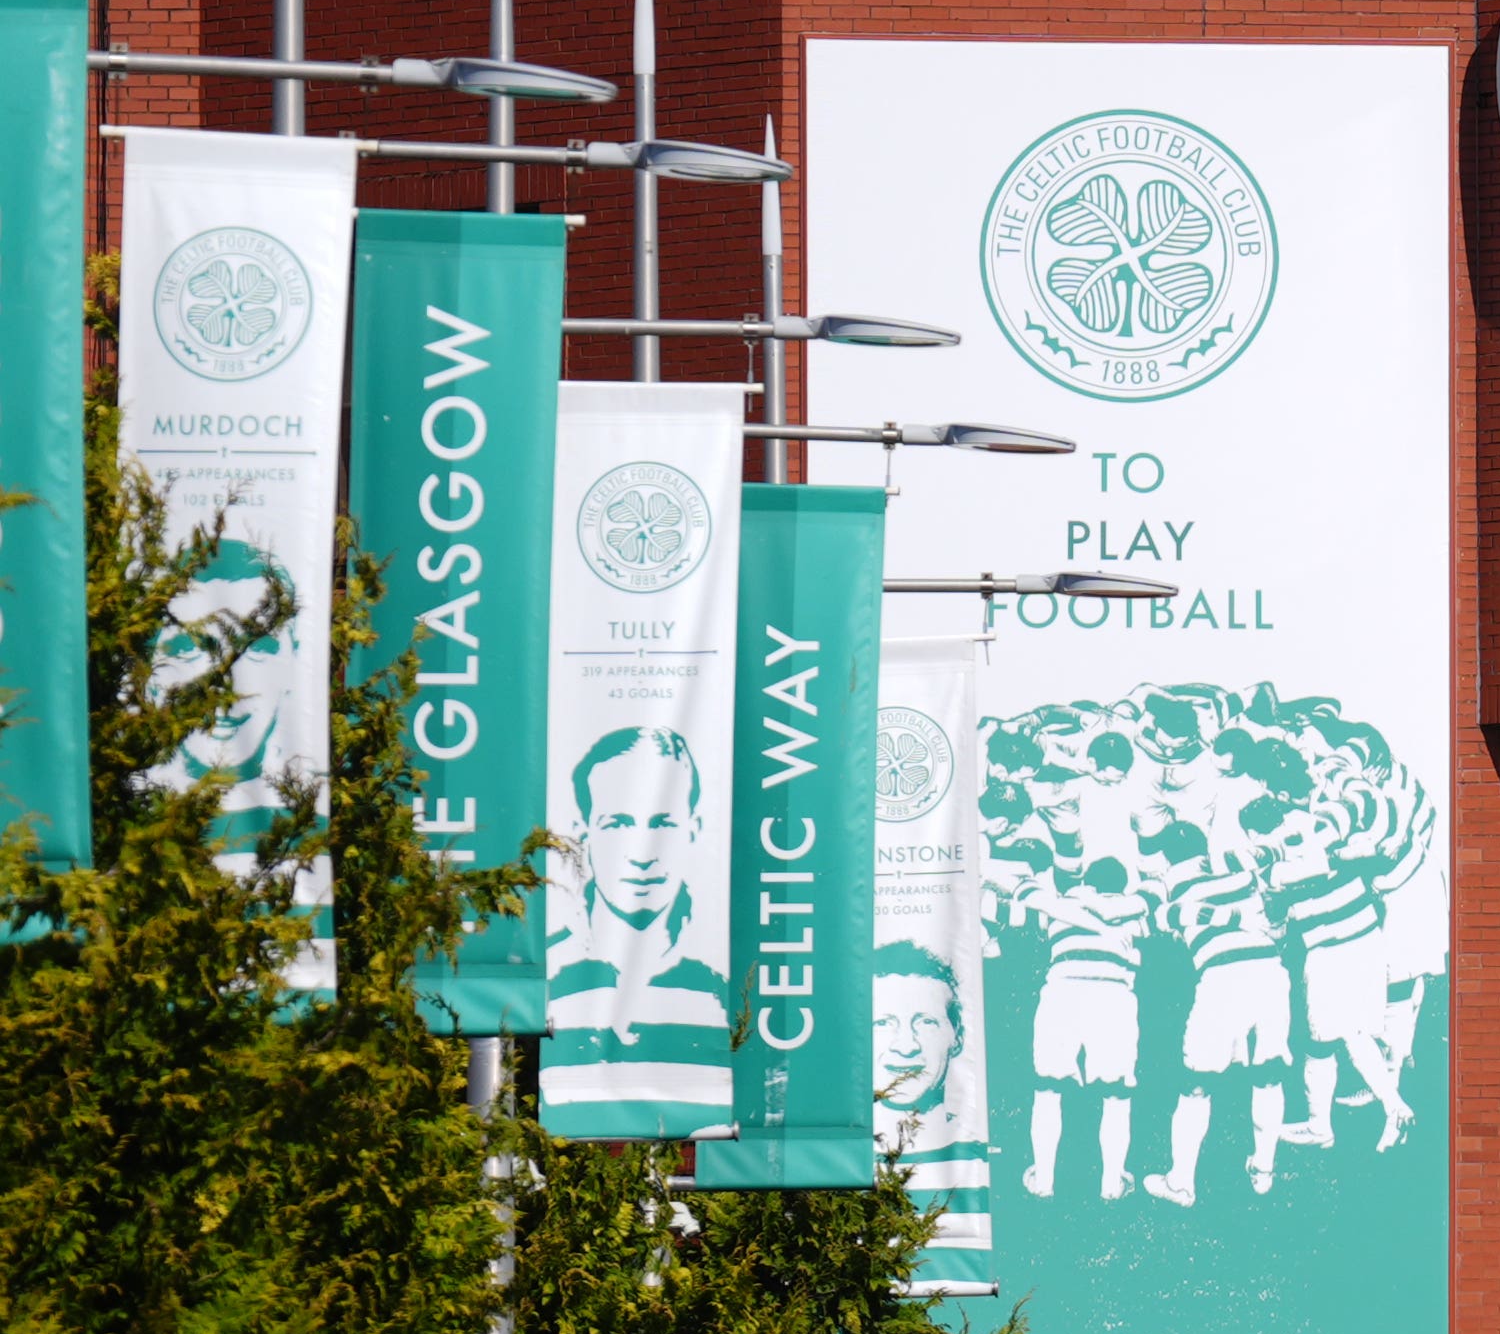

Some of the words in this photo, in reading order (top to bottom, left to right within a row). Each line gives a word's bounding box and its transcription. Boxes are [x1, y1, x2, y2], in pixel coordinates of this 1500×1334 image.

[996, 204, 1030, 258] THE
[1014, 134, 1092, 203] CELTIC
[1097, 125, 1228, 191] FOOTBALL
[1220, 187, 1262, 257] CLUB
[1101, 359, 1160, 384] 1888
[152, 415, 304, 437] MURDOCH
[186, 467, 297, 480] APPEARANCES
[1091, 452, 1165, 494] TO
[213, 493, 266, 507] GALS
[412, 304, 493, 760] GLASGOW
[1066, 518, 1196, 561] PLAY
[607, 621, 675, 640] TULLY
[581, 666, 602, 677] 319
[606, 665, 699, 678] APPEARANCES
[608, 687, 624, 699] 43
[628, 687, 673, 700] GOALS
[760, 624, 820, 789] WAY
[877, 845, 964, 863] NSTONE
[892, 904, 932, 917] GOALS
[757, 816, 816, 1051] CELTIC
